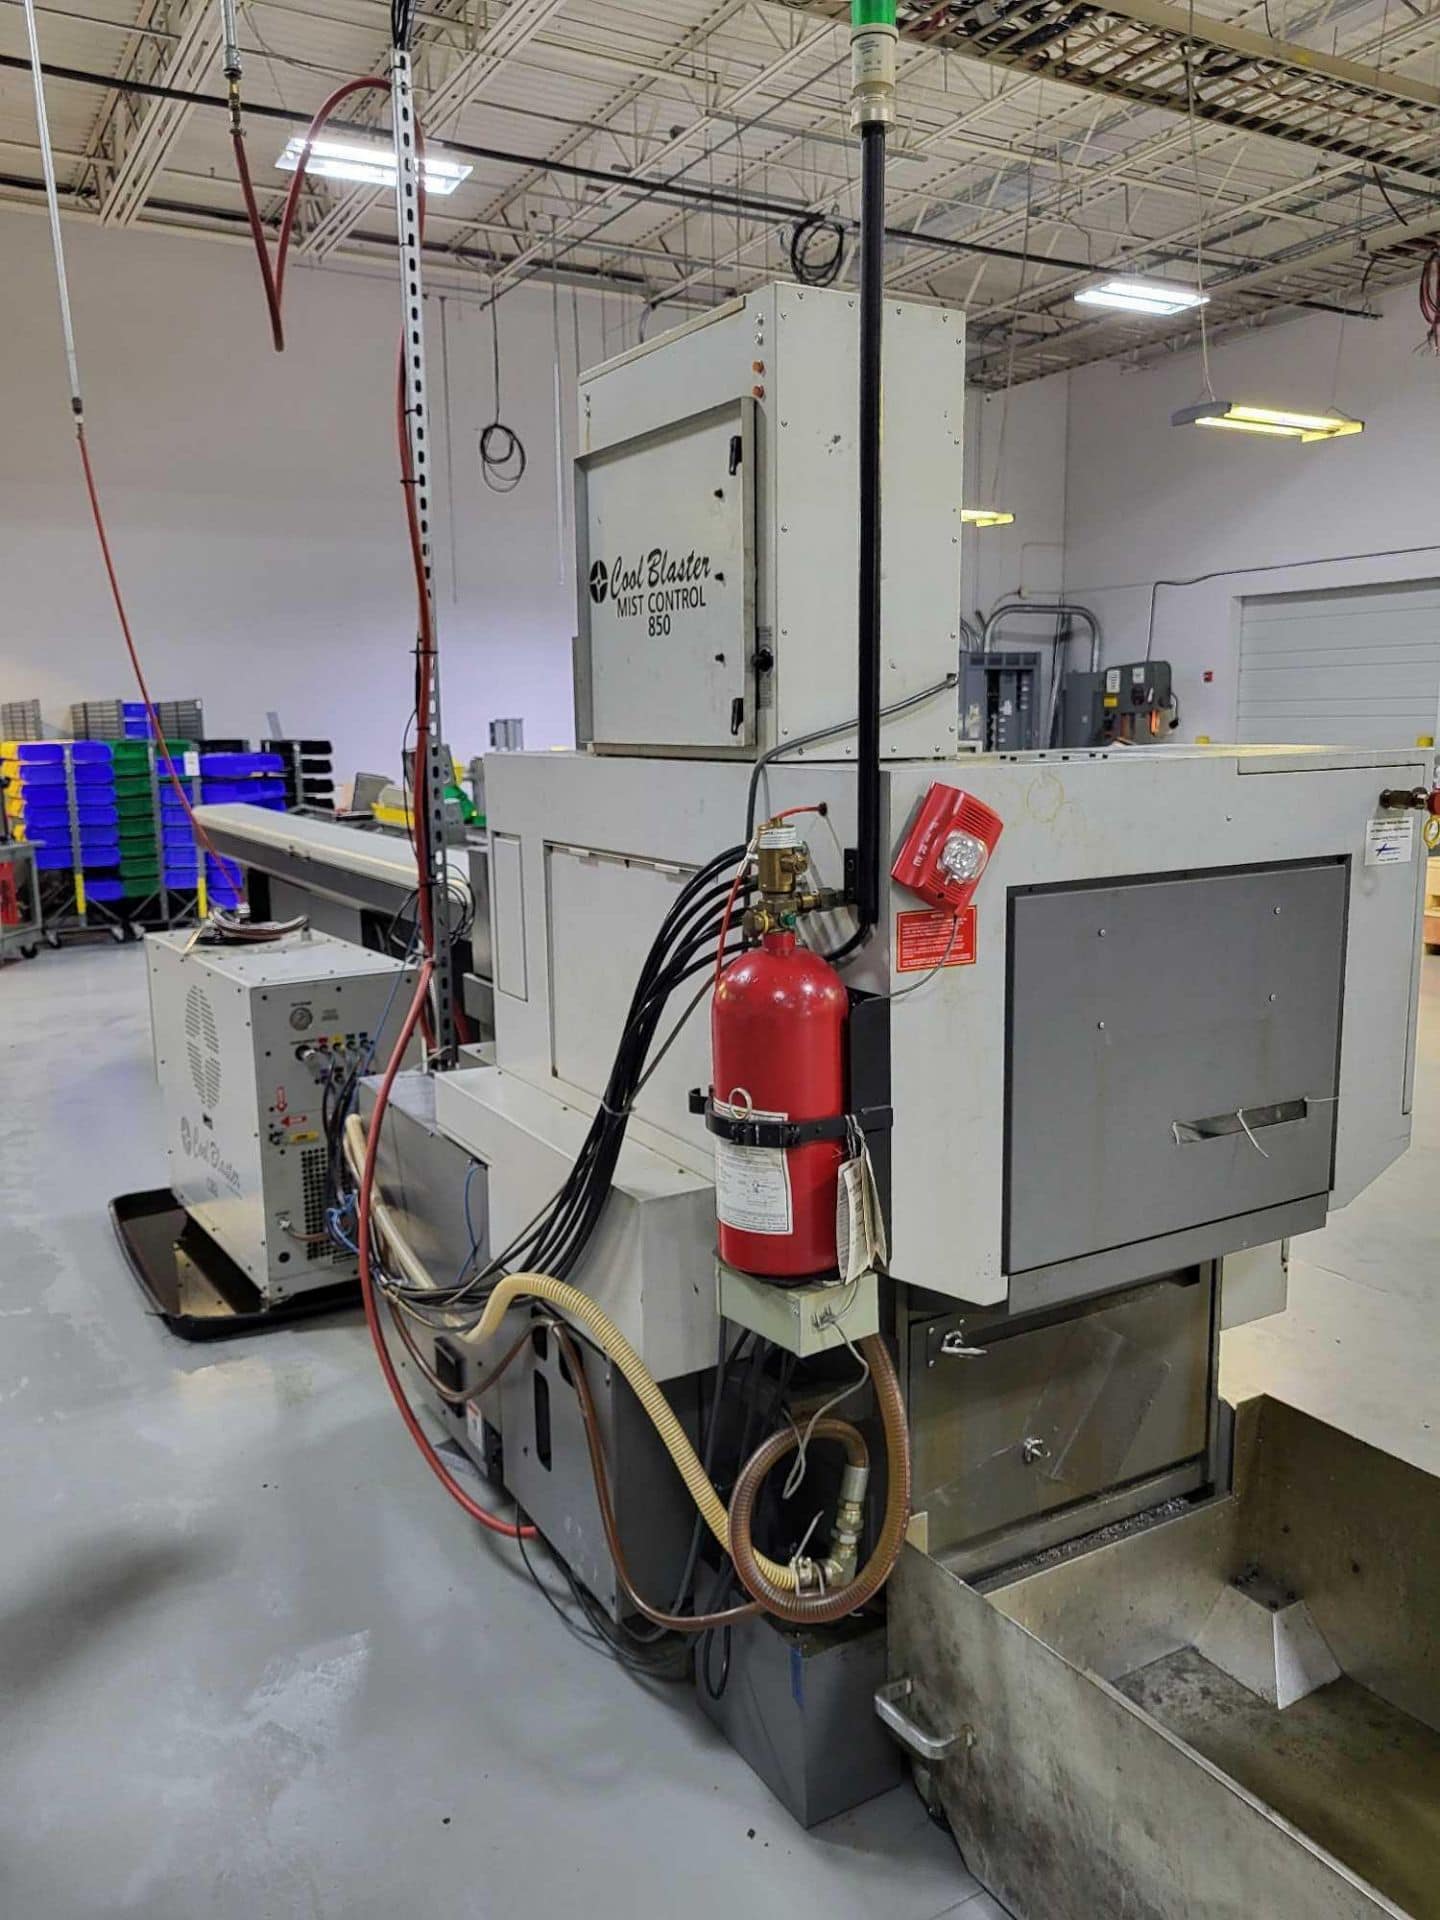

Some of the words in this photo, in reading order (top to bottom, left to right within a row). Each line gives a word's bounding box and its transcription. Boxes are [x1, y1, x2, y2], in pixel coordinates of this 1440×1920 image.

[610, 555, 644, 599] Cool
[647, 548, 711, 587] Blaster
[617, 595, 644, 618] MIST
[648, 586, 706, 613] CONTROL
[648, 614, 671, 637] 850
